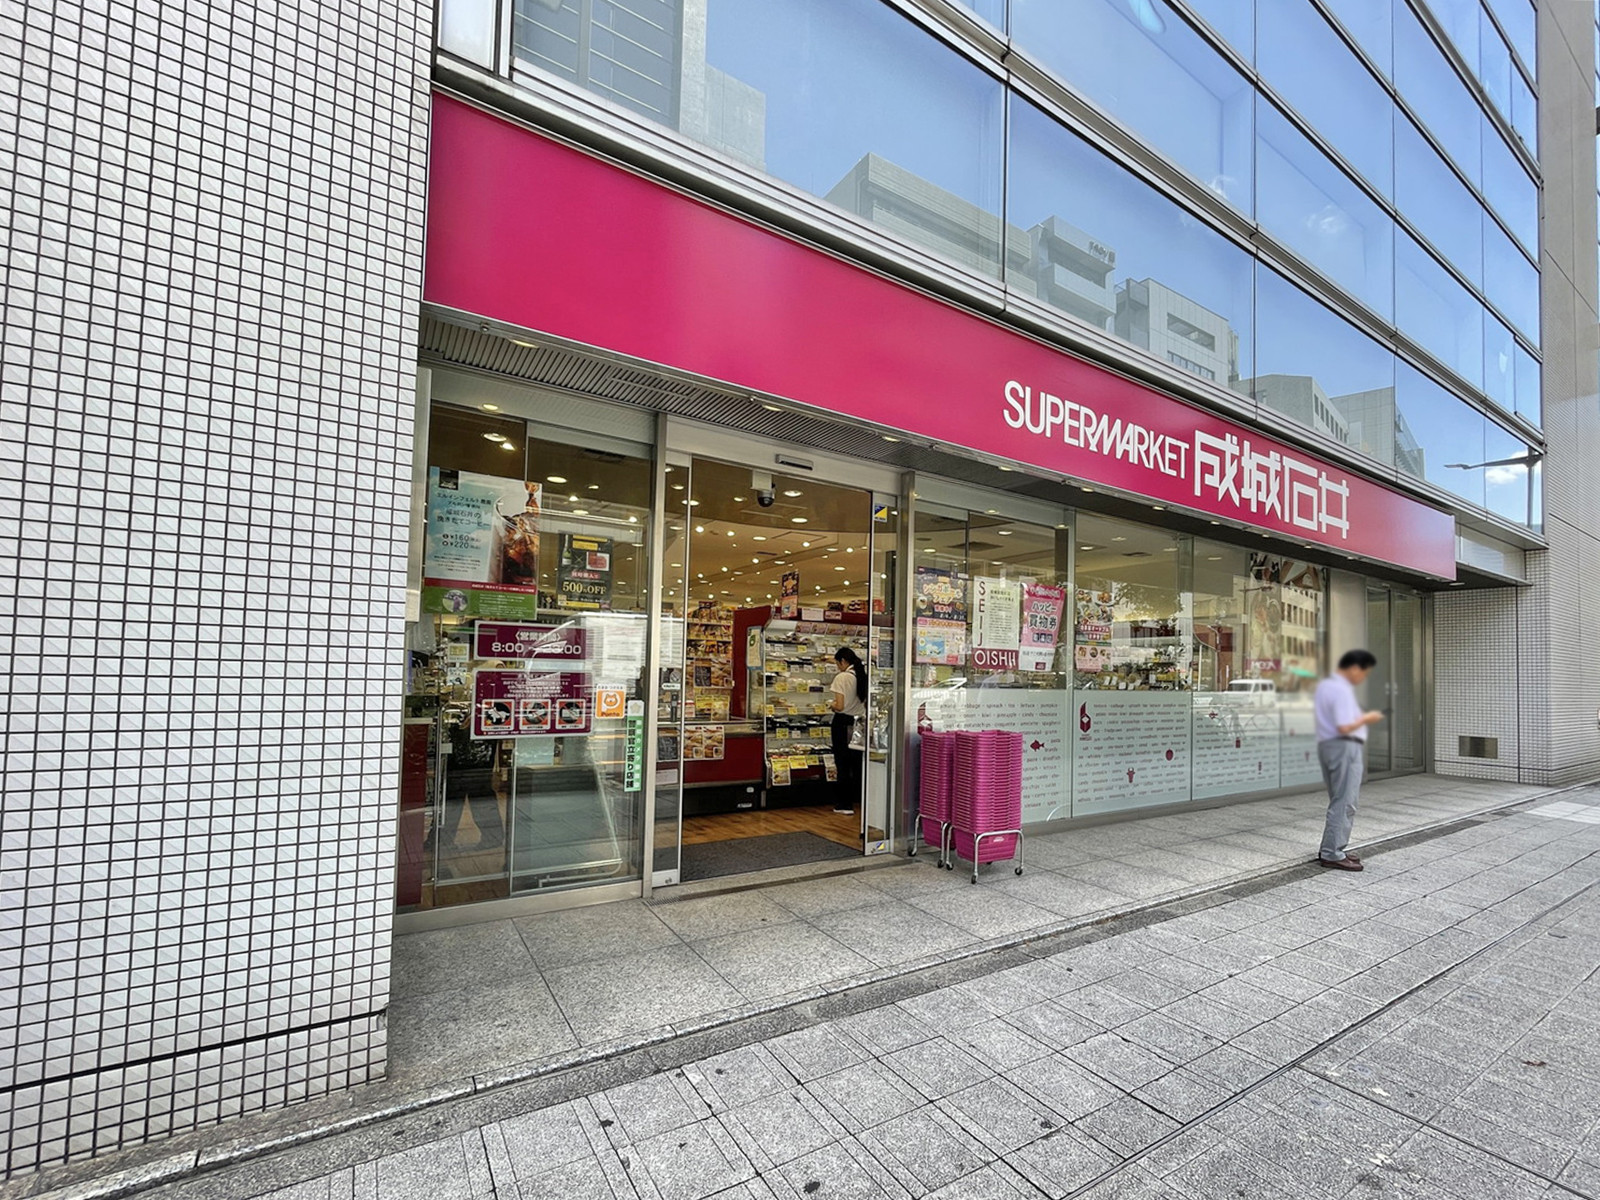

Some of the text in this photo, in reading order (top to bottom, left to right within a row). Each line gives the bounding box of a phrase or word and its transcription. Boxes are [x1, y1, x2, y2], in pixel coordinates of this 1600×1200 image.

[1003, 380, 1349, 539] SUPERMARKET 成城石井
[1031, 601, 1057, 613] ハッピー
[1028, 613, 1057, 631] 買物券
[491, 642, 524, 652] 8:00
